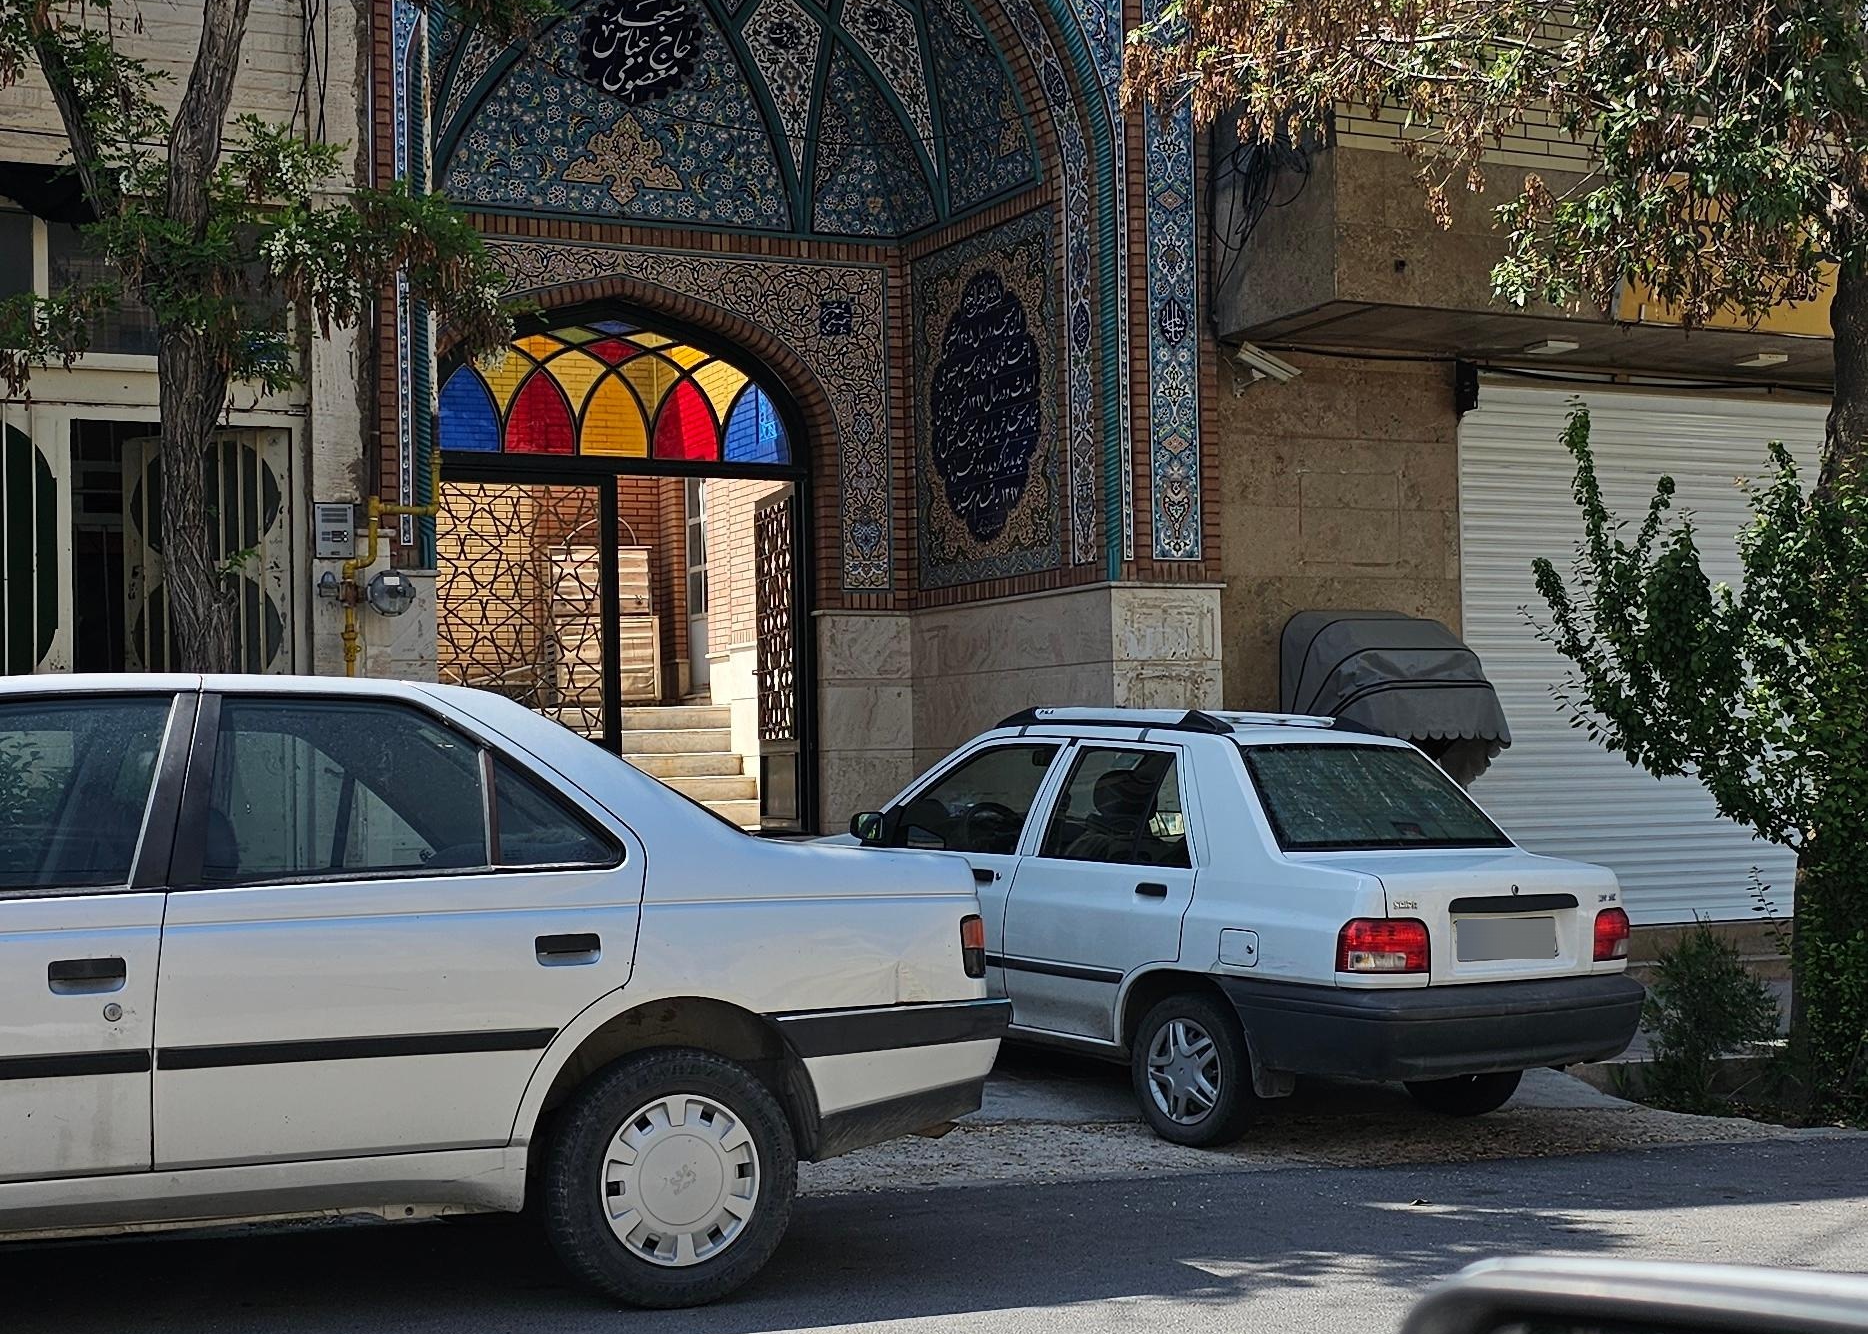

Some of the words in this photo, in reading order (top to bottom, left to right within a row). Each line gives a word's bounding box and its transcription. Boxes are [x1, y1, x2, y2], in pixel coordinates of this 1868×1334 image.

[608, 4, 685, 33] مسجد
[592, 28, 651, 64] عباس
[649, 30, 692, 70] حاج
[602, 57, 679, 97] معصومی
[972, 322, 989, 348] سال
[993, 306, 1016, 337] مسجد
[1008, 309, 1021, 336] این
[981, 353, 993, 380] حاج
[984, 383, 1000, 412] سال
[1005, 404, 1030, 437] مسجد
